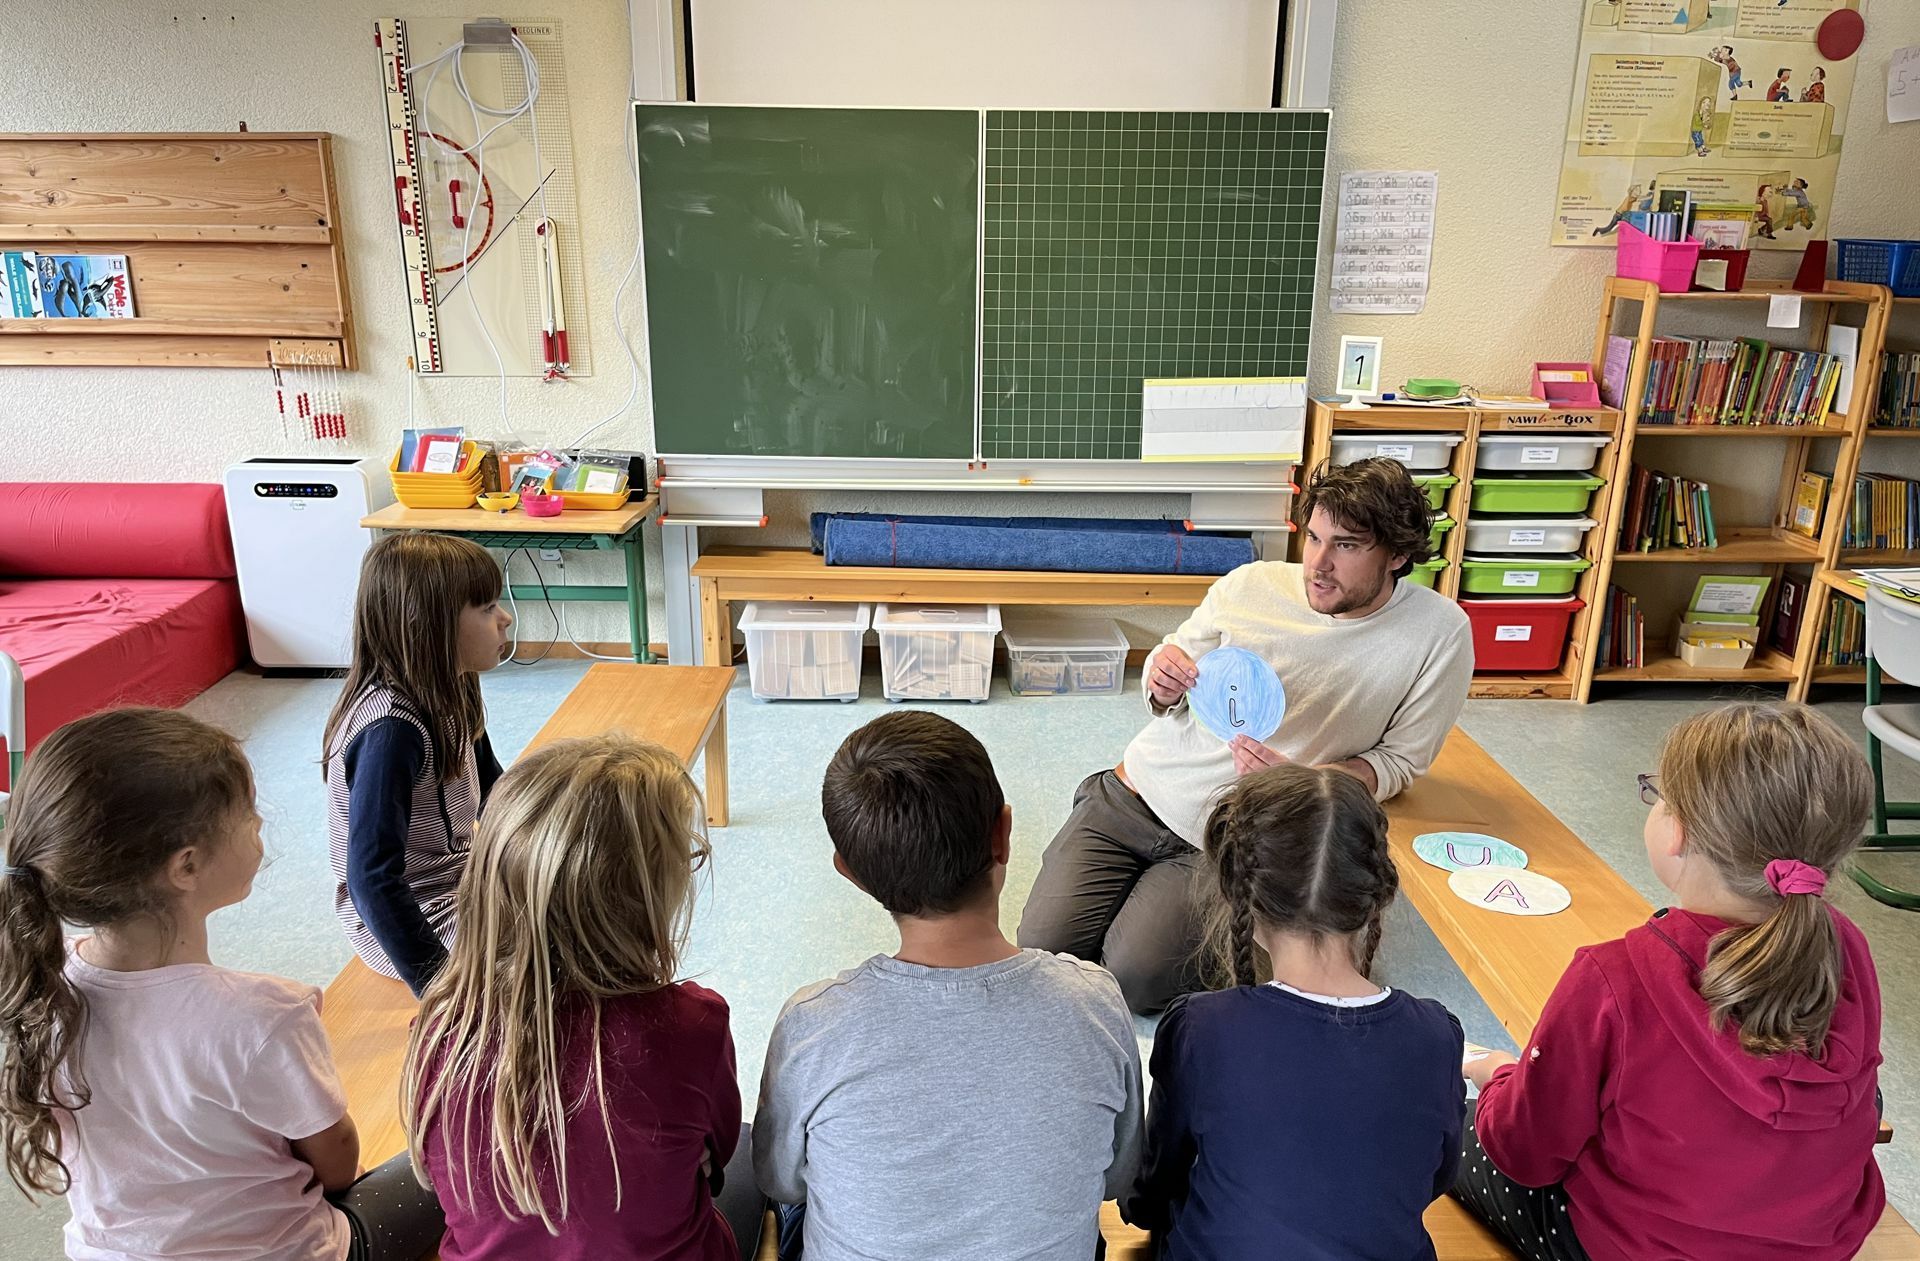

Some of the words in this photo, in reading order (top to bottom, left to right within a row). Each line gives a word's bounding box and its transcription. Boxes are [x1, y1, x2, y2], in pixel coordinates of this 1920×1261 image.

[112, 274, 127, 307] Wale
[1355, 355, 1364, 385] 1
[1507, 415, 1537, 424] NAWI
[1564, 414, 1594, 426] BOX
[1446, 842, 1492, 868] U
[1484, 879, 1529, 909] A
